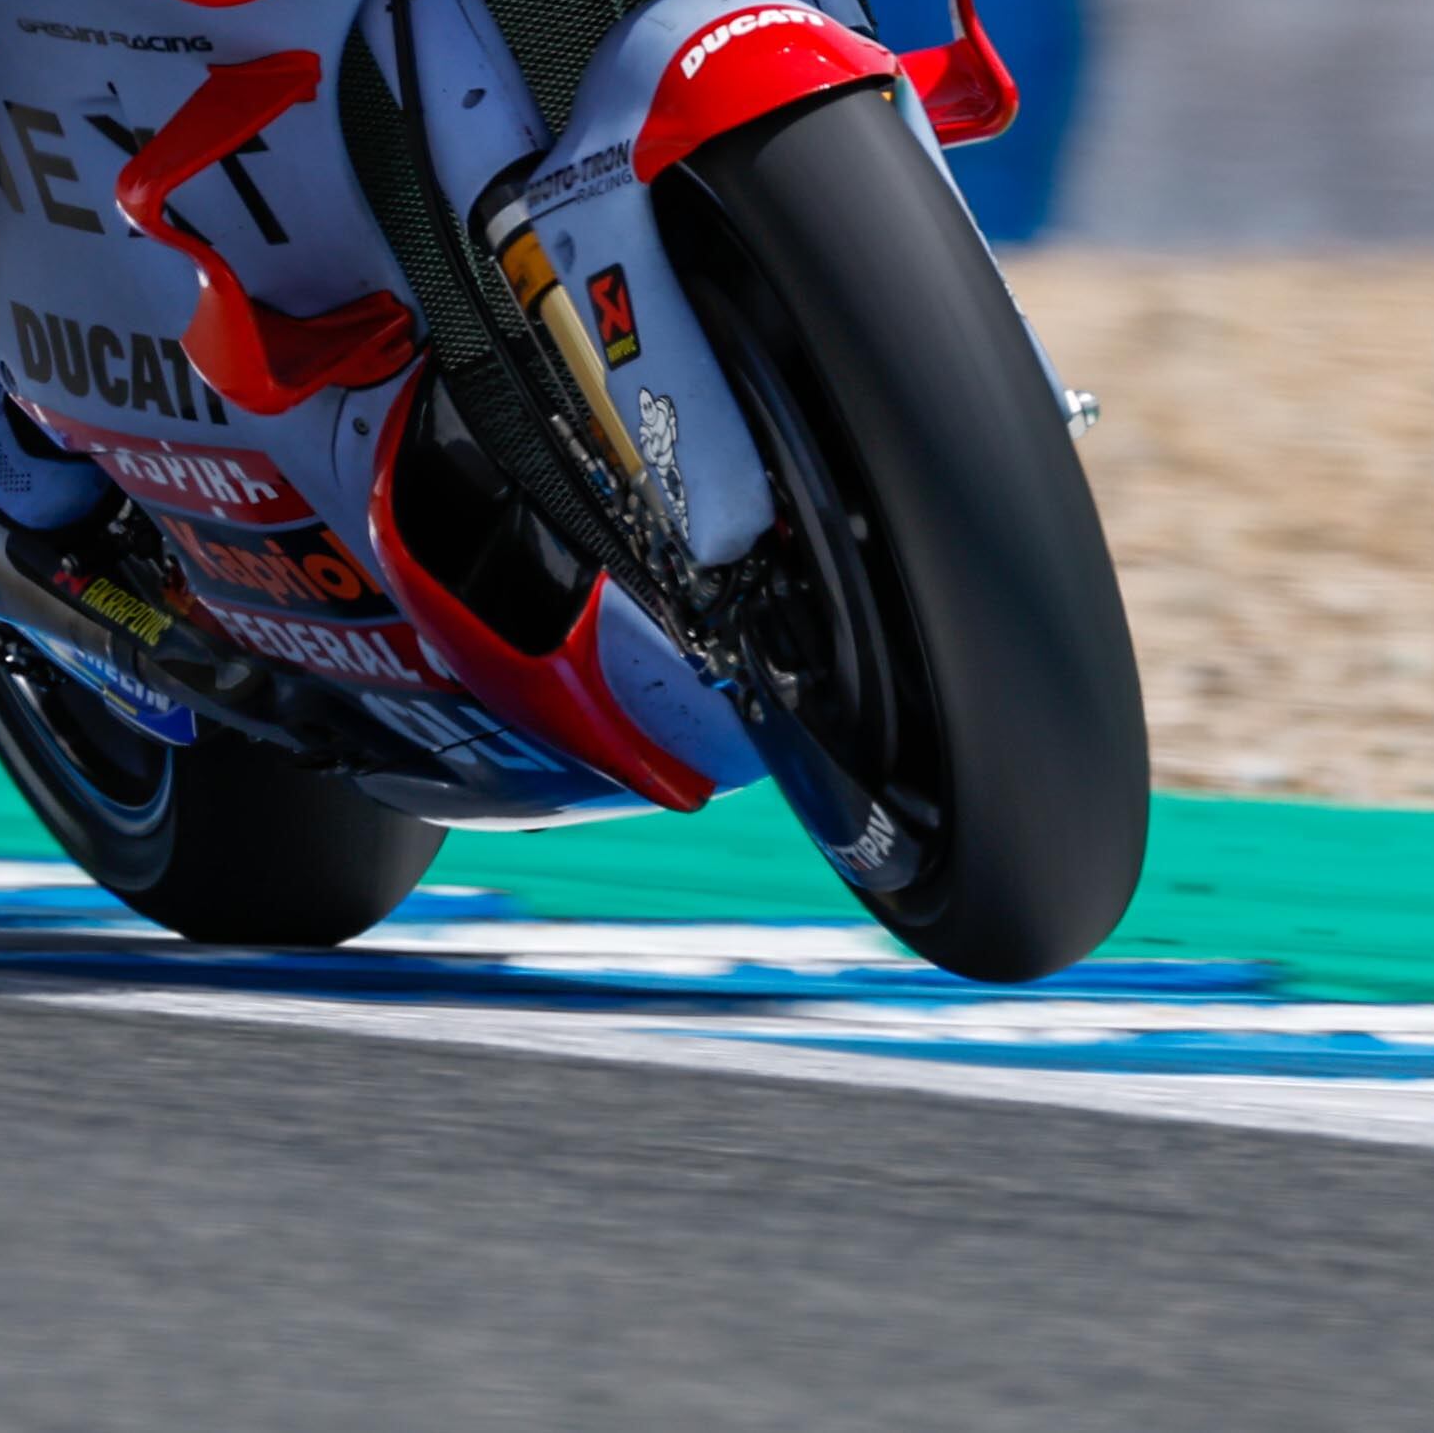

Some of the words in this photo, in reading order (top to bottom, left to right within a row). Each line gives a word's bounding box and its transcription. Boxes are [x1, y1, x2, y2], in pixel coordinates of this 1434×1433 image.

[680, 7, 825, 82] DUCATI
[161, 514, 387, 607] Kapriol
[207, 606, 423, 684] FEDERAL
